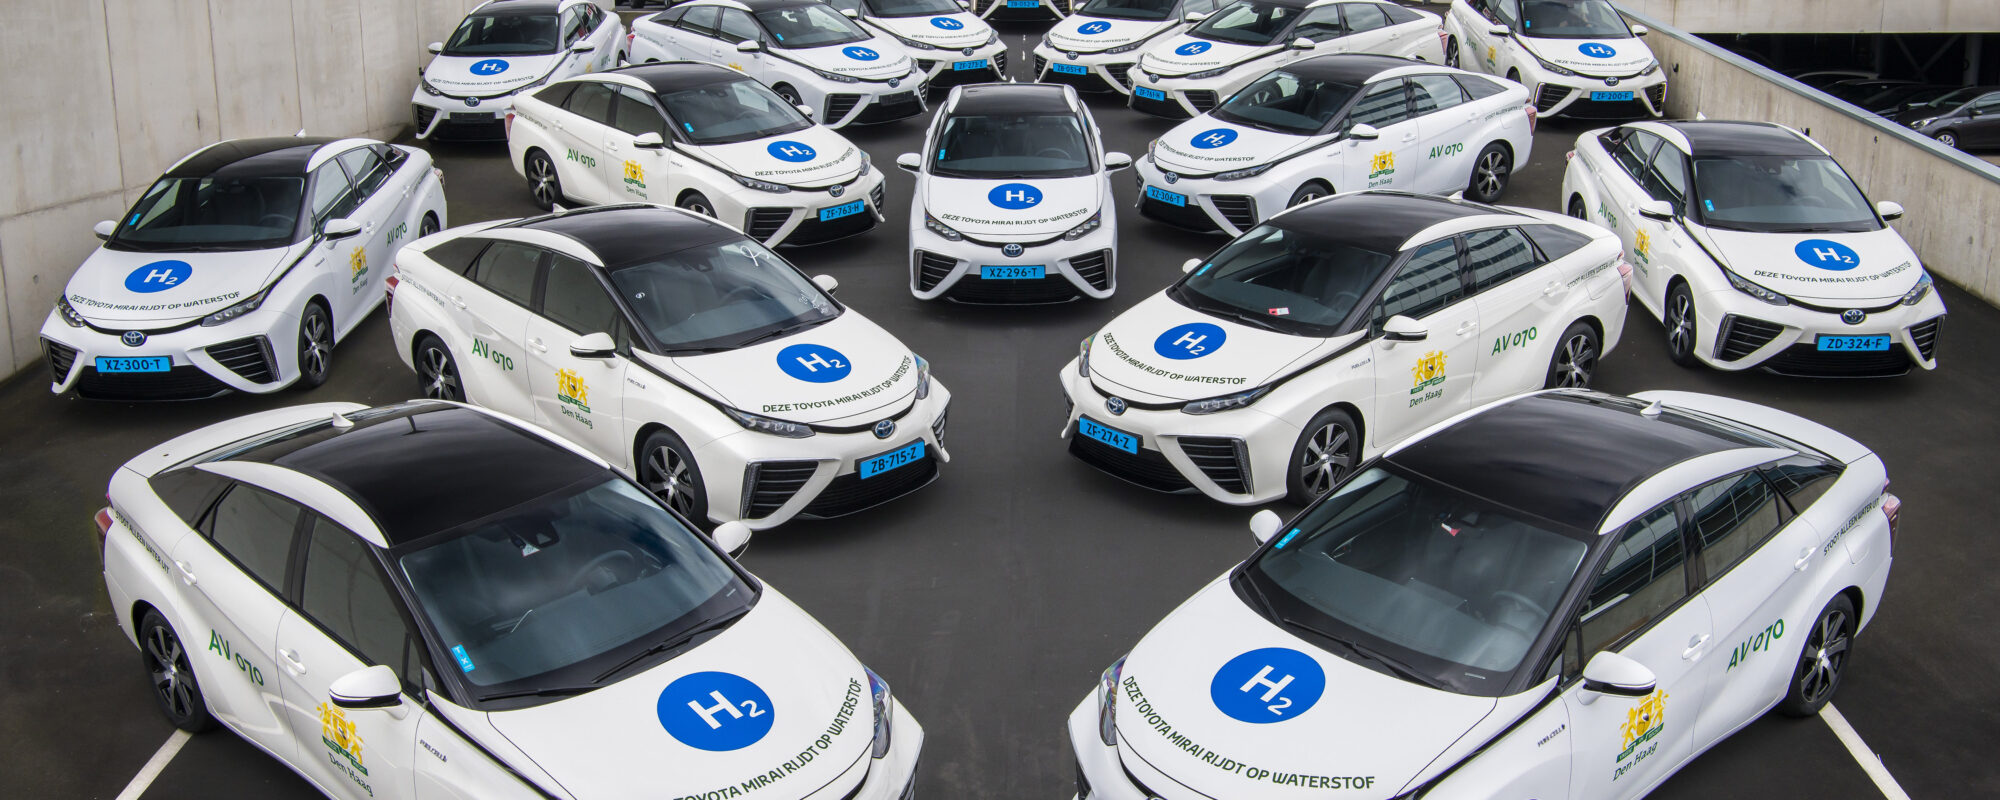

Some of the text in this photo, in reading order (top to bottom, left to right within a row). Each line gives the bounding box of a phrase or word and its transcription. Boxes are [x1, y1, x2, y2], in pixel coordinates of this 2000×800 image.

[851, 49, 877, 58] H2
[1589, 46, 1612, 55] H2
[481, 63, 502, 72] H2
[1202, 133, 1226, 146] H2
[566, 148, 596, 168] AV 070
[780, 146, 814, 156] H2
[1429, 142, 1464, 160] AV 070
[1368, 181, 1379, 189] Den
[1006, 190, 1035, 204] H2
[1152, 189, 1180, 203] XZ-306-T
[826, 202, 859, 218] ZF-763-H
[942, 213, 960, 221] DEZE
[961, 216, 990, 224] TOYOTA
[1050, 207, 1088, 222] WATERSTOF
[386, 227, 395, 248] AV
[1813, 247, 1855, 264] H2
[144, 268, 179, 285] H2
[990, 268, 1037, 277] XZ-296-T
[1754, 270, 1778, 278] DEZE
[1780, 273, 1818, 283] TOYOTA
[70, 294, 87, 303] DEZE
[85, 298, 113, 309] TOYOTA
[183, 291, 240, 308] WATERSTOF
[1172, 331, 1208, 355] H2
[1492, 326, 1538, 356] AV 070
[1827, 338, 1883, 349] ZD-324-F
[105, 359, 160, 370] XZ-300-T
[472, 338, 514, 371] AV 070
[795, 353, 846, 372] H2
[1103, 332, 1114, 345] DEZE
[1110, 340, 1128, 361] TOYOTA
[1126, 357, 1147, 370] MIRAI
[1145, 366, 1170, 377] RIJDT
[1184, 375, 1247, 385] WATERSTOF
[762, 355, 912, 413] DEZE TOYOTA MIRAI RIJDT OP WATERSTOF
[1409, 397, 1423, 408] Den
[1424, 388, 1442, 402] Haag
[561, 405, 575, 418] Den
[575, 411, 593, 430] Haag
[1087, 422, 1130, 449] ZF-274-Z
[871, 447, 916, 473] ZB-715-Z
[1824, 531, 1840, 557] STOOT
[1840, 514, 1858, 537] ALLEEN
[1858, 502, 1872, 520] WATER
[115, 510, 169, 574] STOOT ALLEEN WATER UIT
[1726, 618, 1784, 673] AV 070
[209, 629, 264, 687] AV 070
[1239, 664, 1296, 716] H2
[687, 690, 766, 730] H2
[741, 767, 786, 793] MIRAI
[782, 745, 820, 774] RIJDT
[815, 733, 833, 750] OP
[826, 677, 862, 736] WATERSTOF
[1123, 675, 1375, 790] DEZE TOYOTA MIRAI RIJDT OP WATERSTOF
[1613, 761, 1632, 782] Den
[1634, 742, 1658, 766] Haag
[328, 751, 348, 774] Den
[347, 766, 373, 797] Haag
